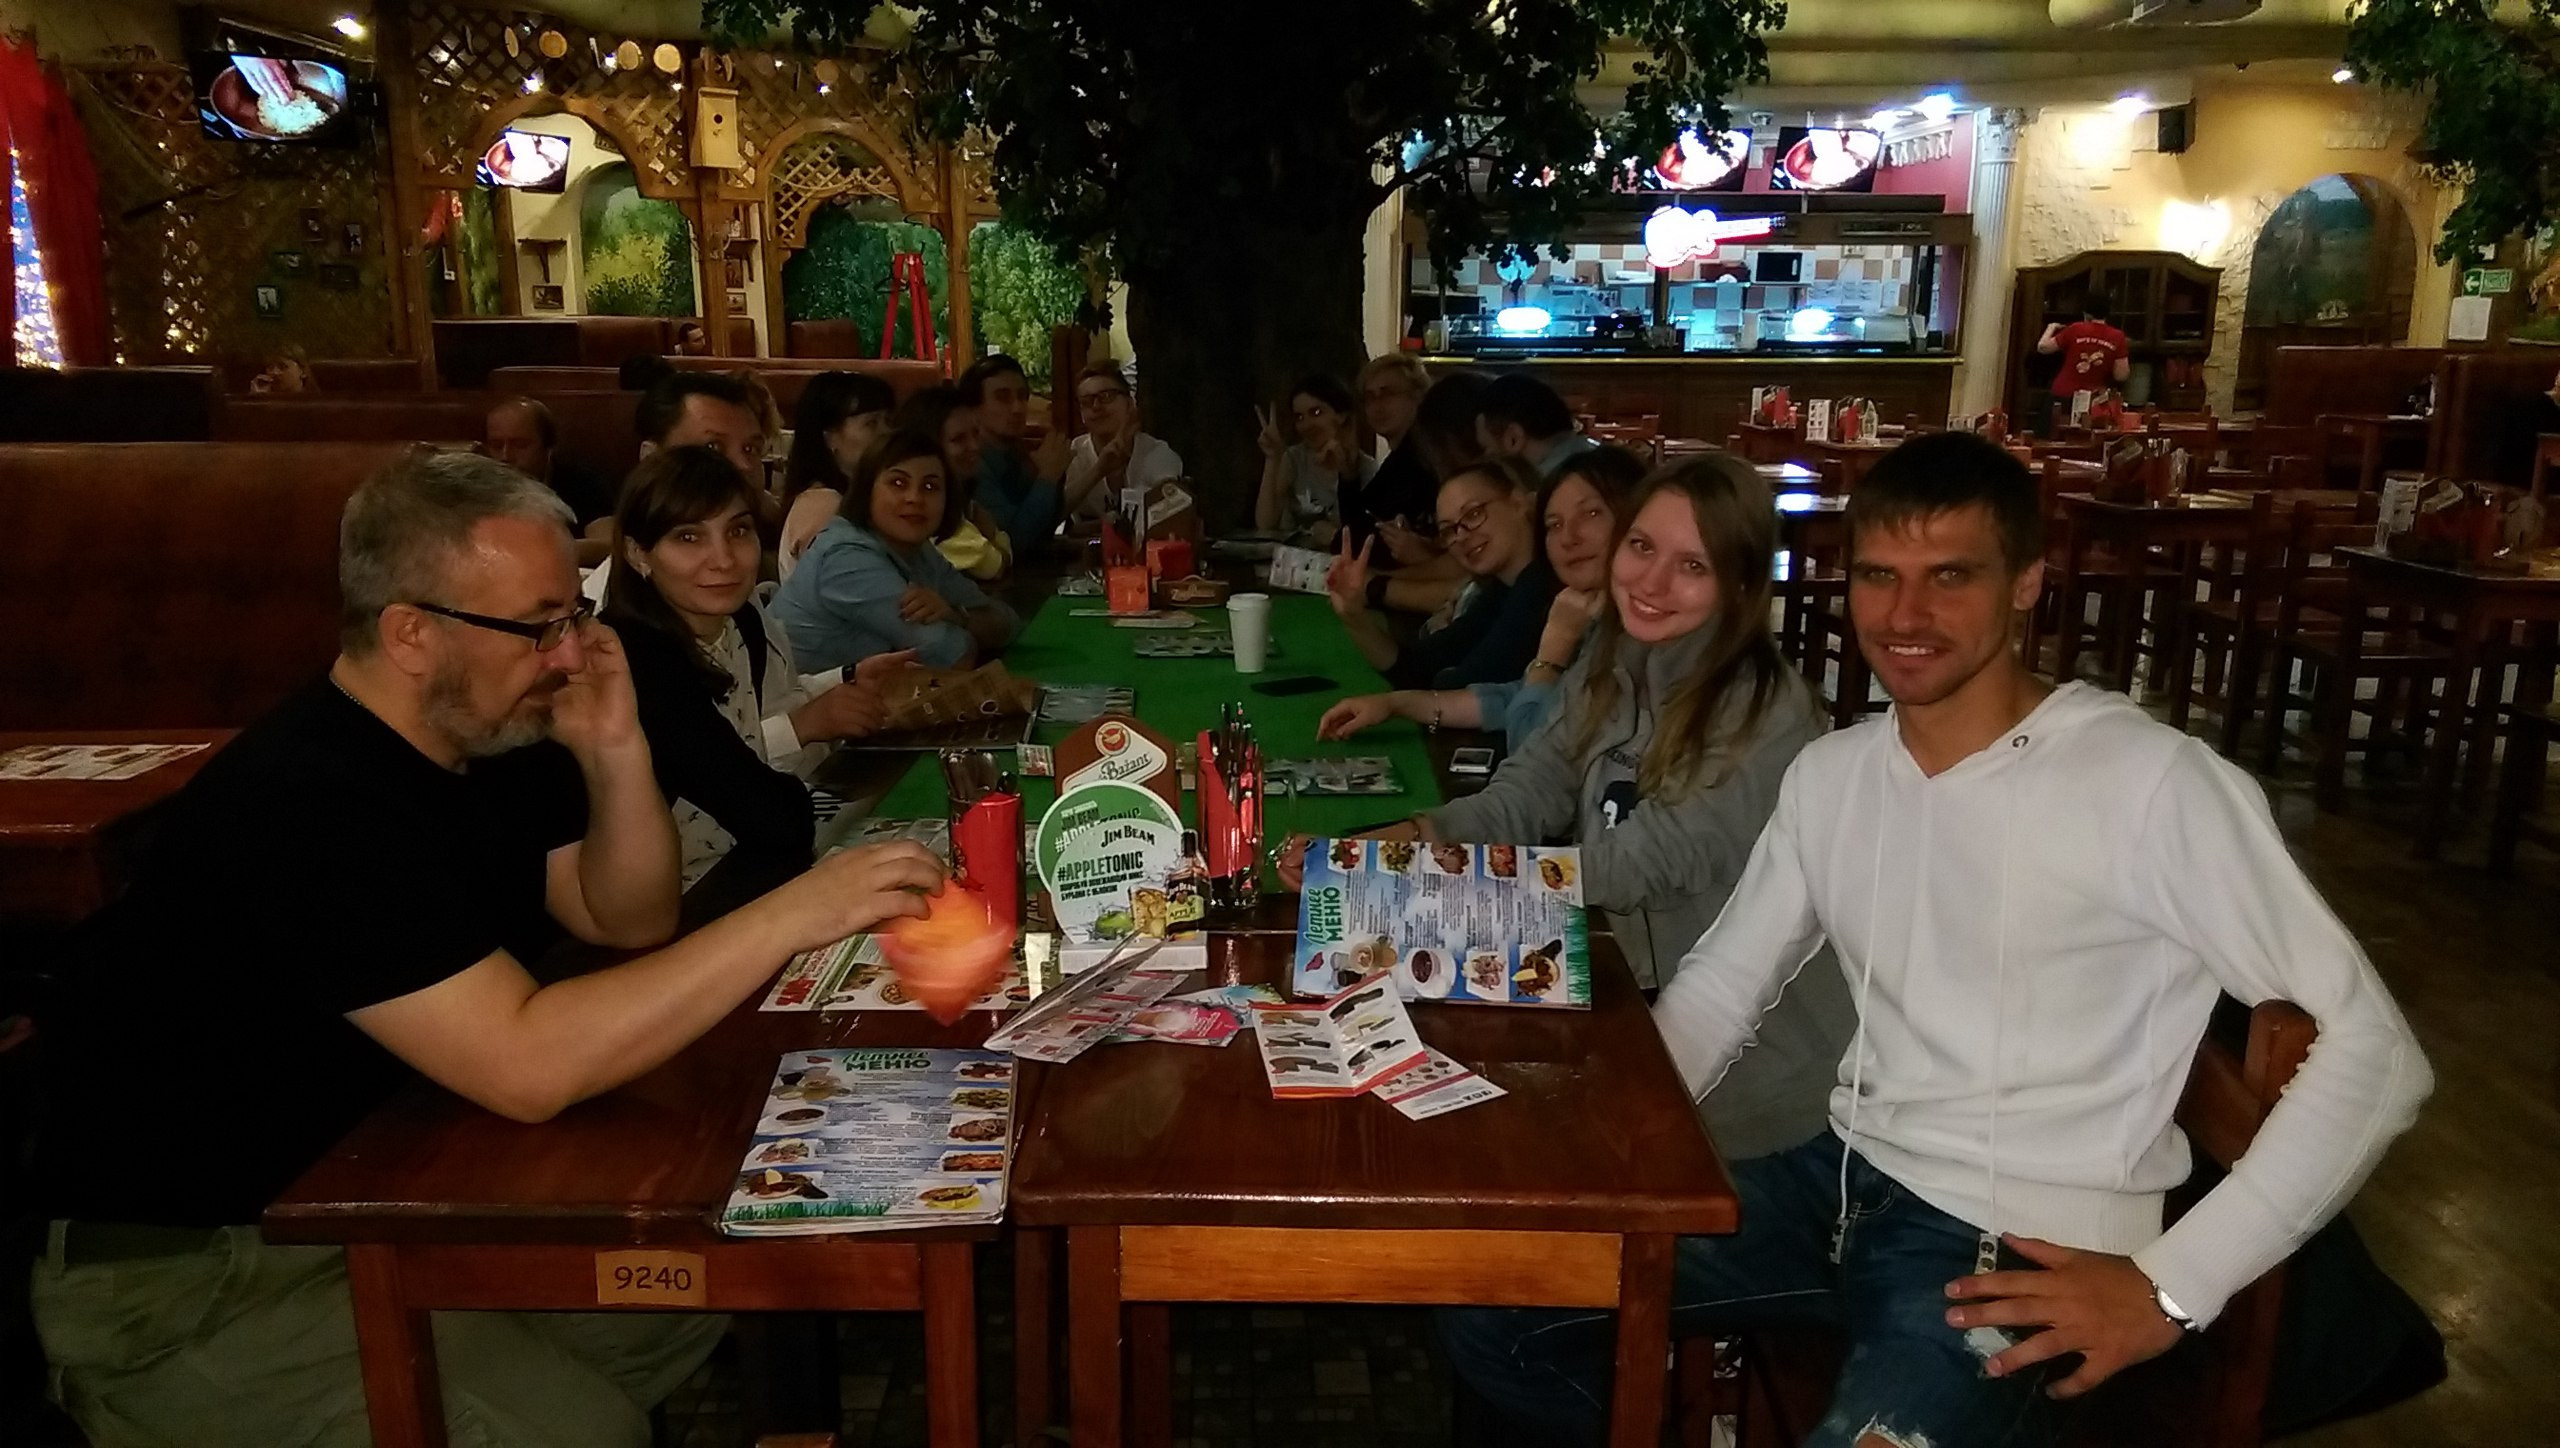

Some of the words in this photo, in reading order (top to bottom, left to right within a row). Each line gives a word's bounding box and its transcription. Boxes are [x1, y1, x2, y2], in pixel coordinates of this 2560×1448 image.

[1058, 851, 1144, 882] #APPLETONIC
[1325, 886, 1343, 942] МЕНЮ
[845, 1059, 931, 1072] МЕНЮ
[614, 1266, 692, 1291] 9240
